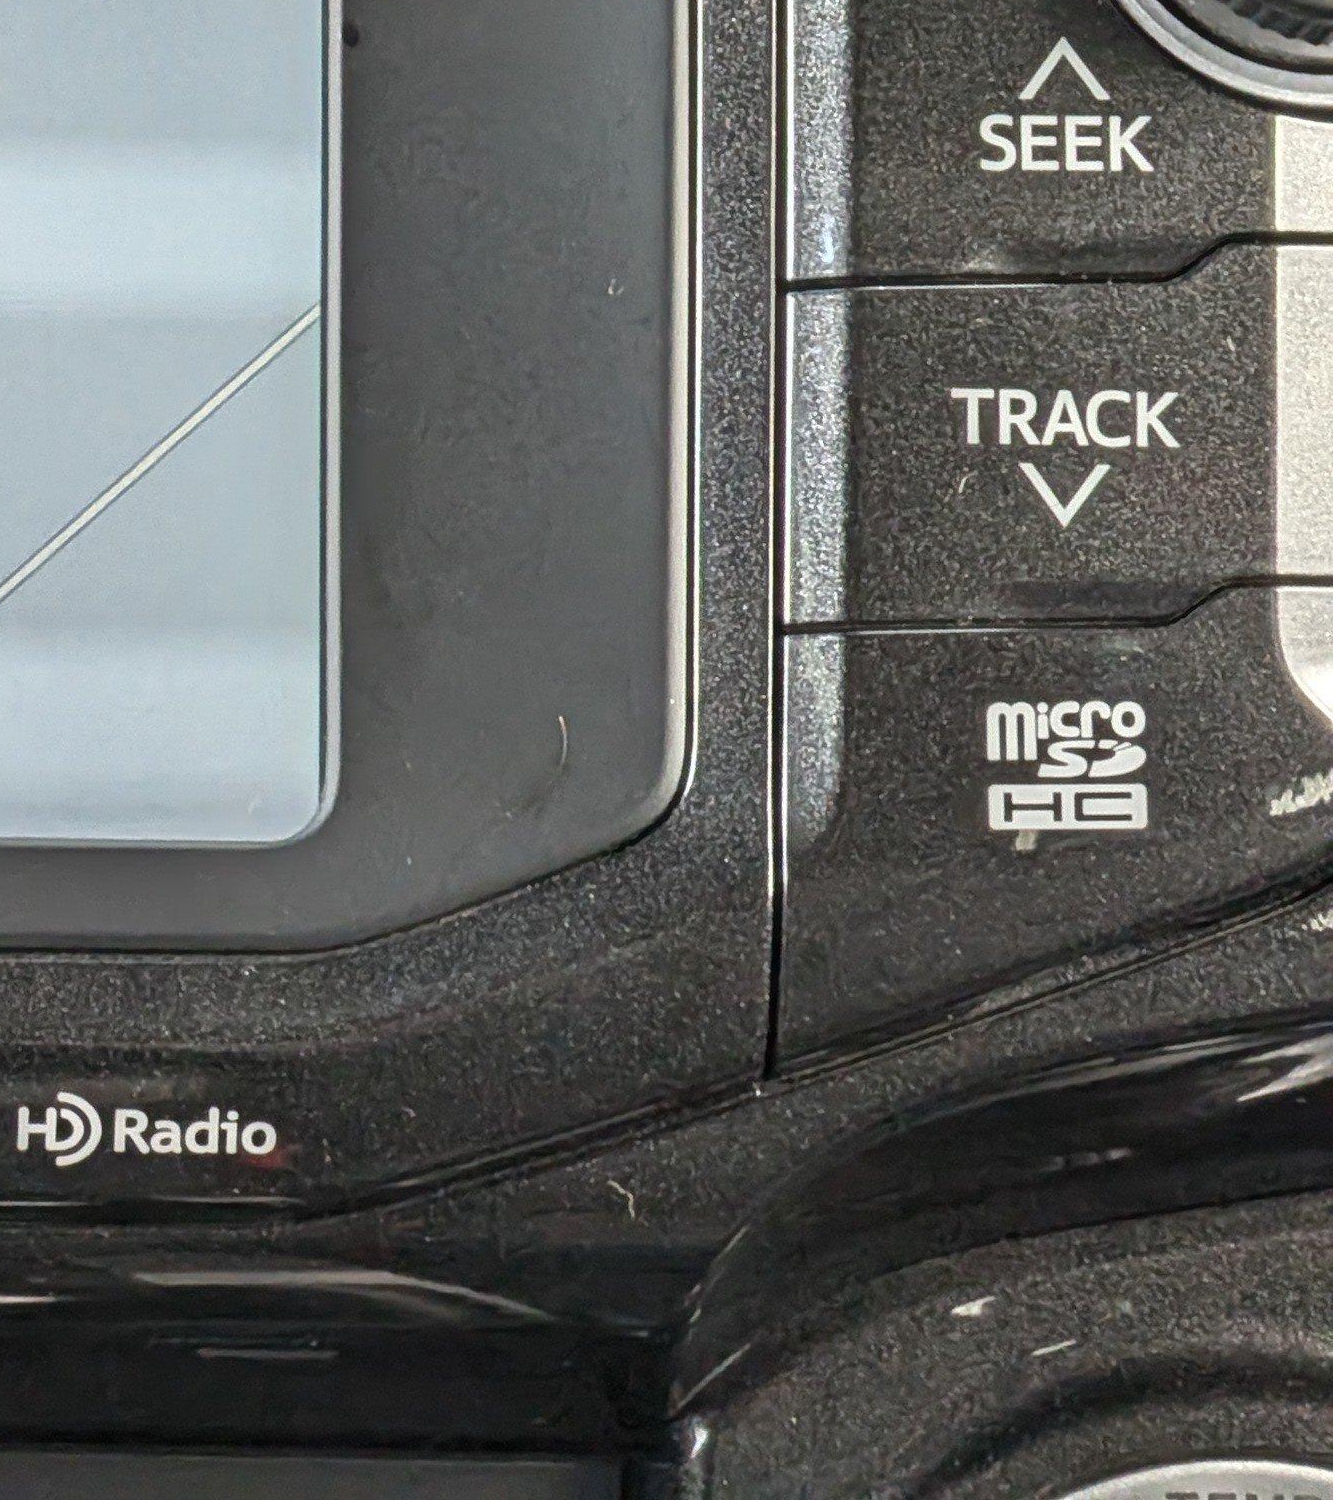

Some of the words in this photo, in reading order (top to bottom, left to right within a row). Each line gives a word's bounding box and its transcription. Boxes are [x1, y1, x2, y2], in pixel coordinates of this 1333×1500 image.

[977, 114, 1155, 174] SEEK
[950, 388, 1181, 449] TRACK
[1002, 790, 1134, 825] HC
[16, 1091, 103, 1167] HD
[112, 1107, 278, 1156] Radio
